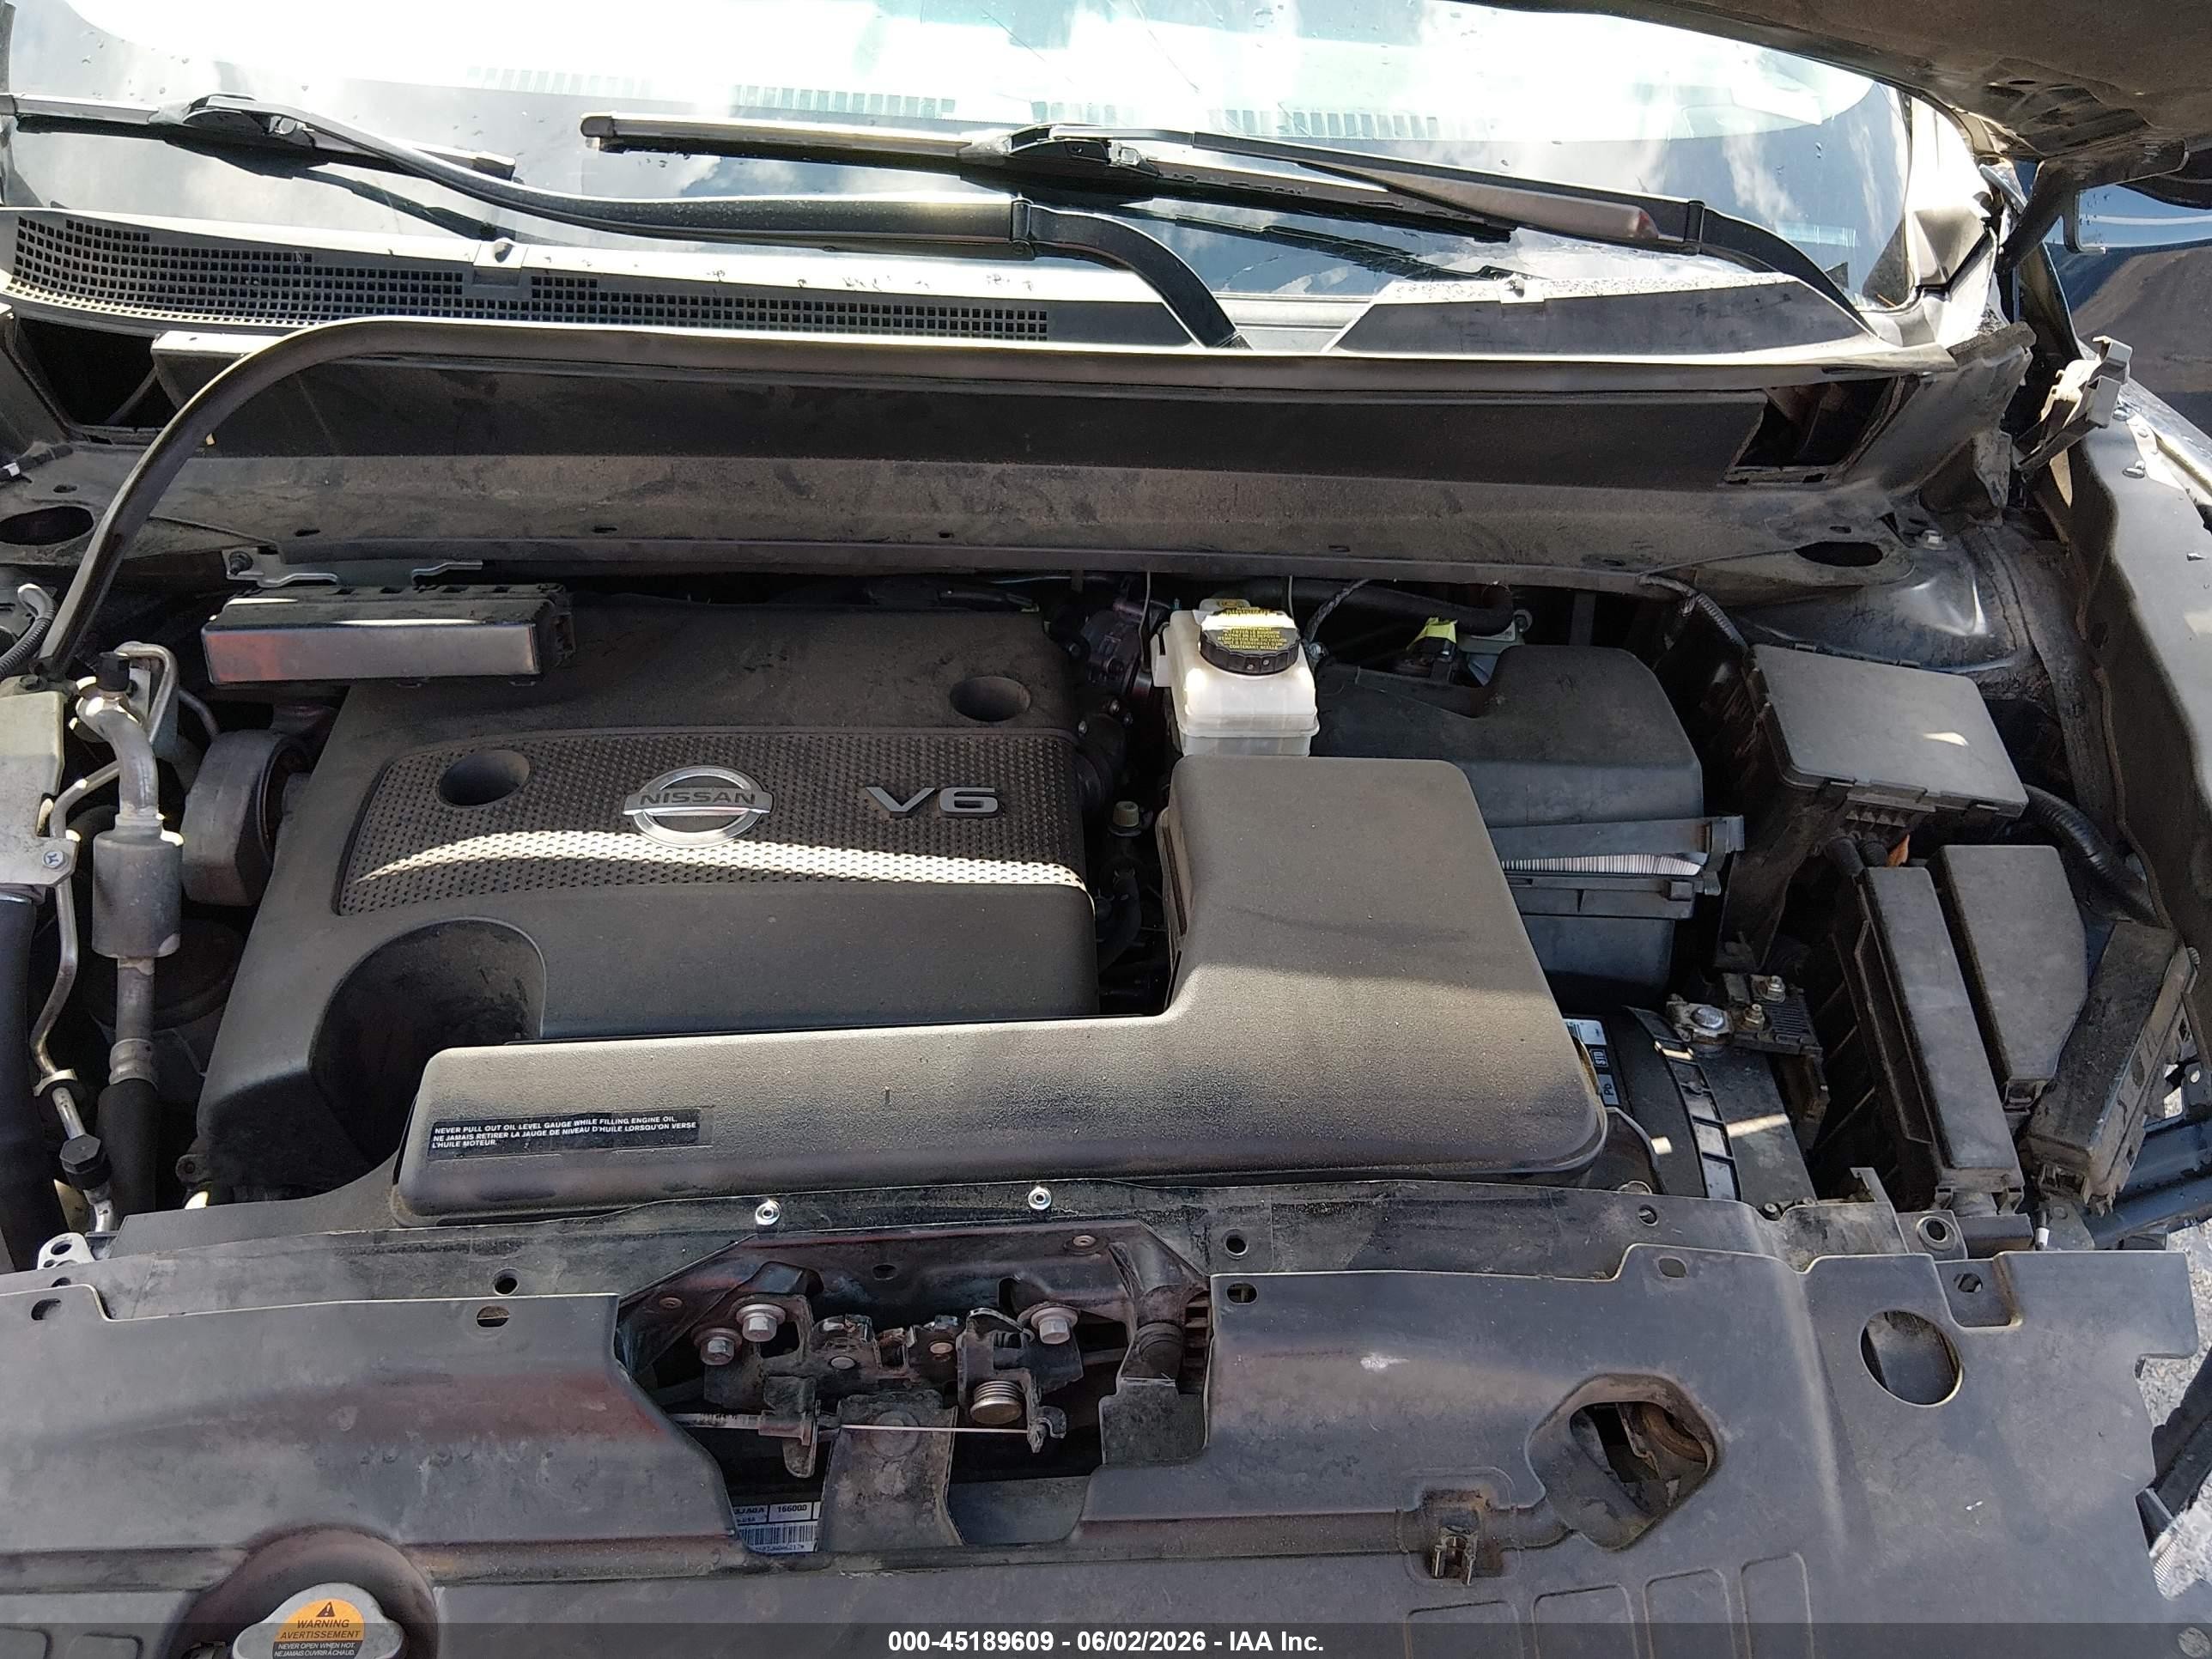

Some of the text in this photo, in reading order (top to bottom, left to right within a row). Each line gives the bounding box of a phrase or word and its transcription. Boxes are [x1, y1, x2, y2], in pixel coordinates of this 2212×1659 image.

[640, 790, 756, 805] NISSAN
[866, 787, 999, 817] V6
[297, 1620, 349, 1628] WARNING
[280, 1631, 360, 1639] AVERTISSEMENT
